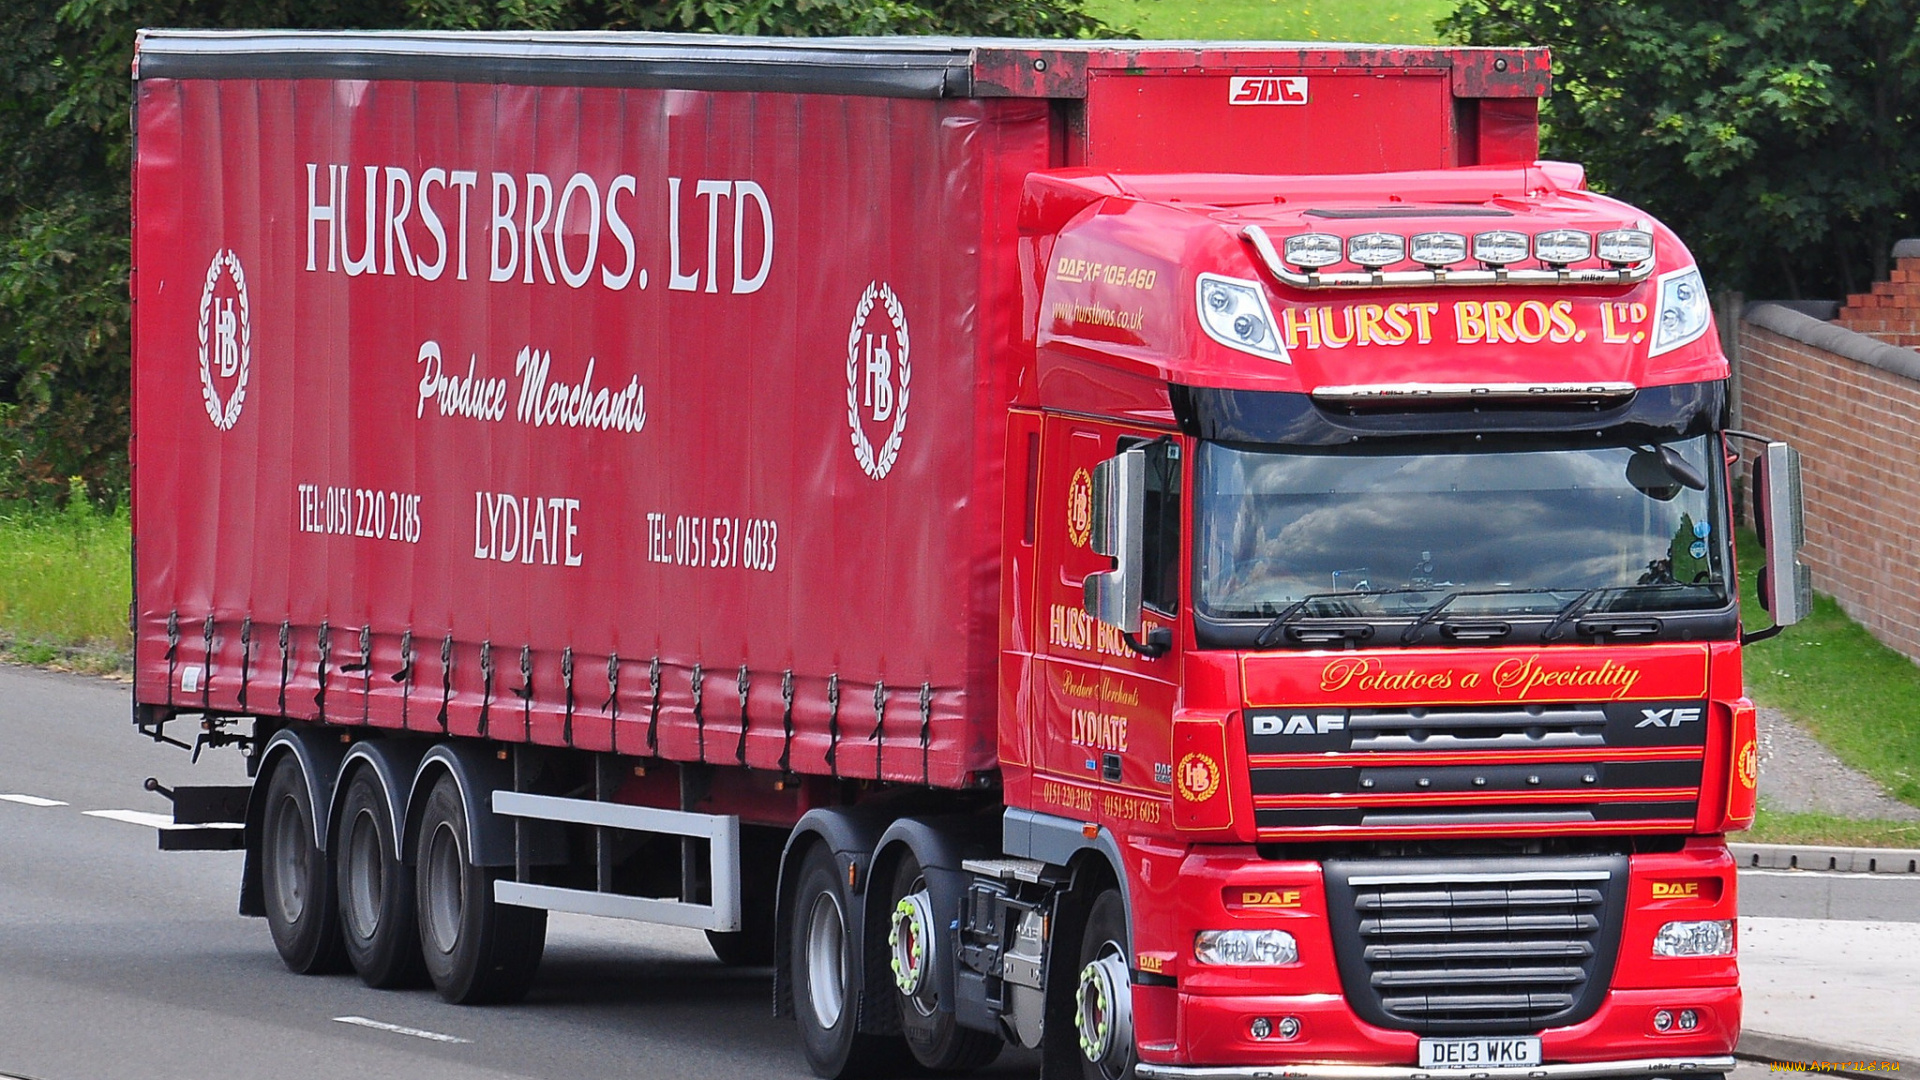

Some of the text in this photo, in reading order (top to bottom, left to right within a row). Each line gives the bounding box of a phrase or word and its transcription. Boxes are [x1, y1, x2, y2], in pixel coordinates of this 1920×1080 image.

[1233, 79, 1304, 102] SDC
[305, 163, 774, 294] HURST BROS. LTD
[1056, 257, 1157, 290] DAF XF 105.460
[1052, 297, 1144, 330] www.hurstbros.co.uk
[1282, 301, 1439, 349] HURST
[1454, 300, 1587, 345] BROS.
[417, 340, 647, 434] Produce Merchants
[298, 484, 421, 544] TEL: 0151 220 2185
[473, 491, 583, 567] LYDIATE
[646, 512, 778, 573] TEL: 0151 531 6033
[1049, 603, 1094, 651] HURST
[1320, 653, 1642, 700] Potatoes a Speciality
[1071, 708, 1128, 752] LYDIATE
[1252, 714, 1345, 735] DAF
[1634, 708, 1701, 728] XF
[1154, 762, 1173, 775] DAF
[1043, 782, 1061, 805] 0151
[1139, 800, 1161, 824] 6033
[1242, 891, 1301, 908] DAF
[1652, 882, 1699, 899] DAF
[1140, 956, 1163, 973] DAF
[1487, 1041, 1527, 1061] WKG
